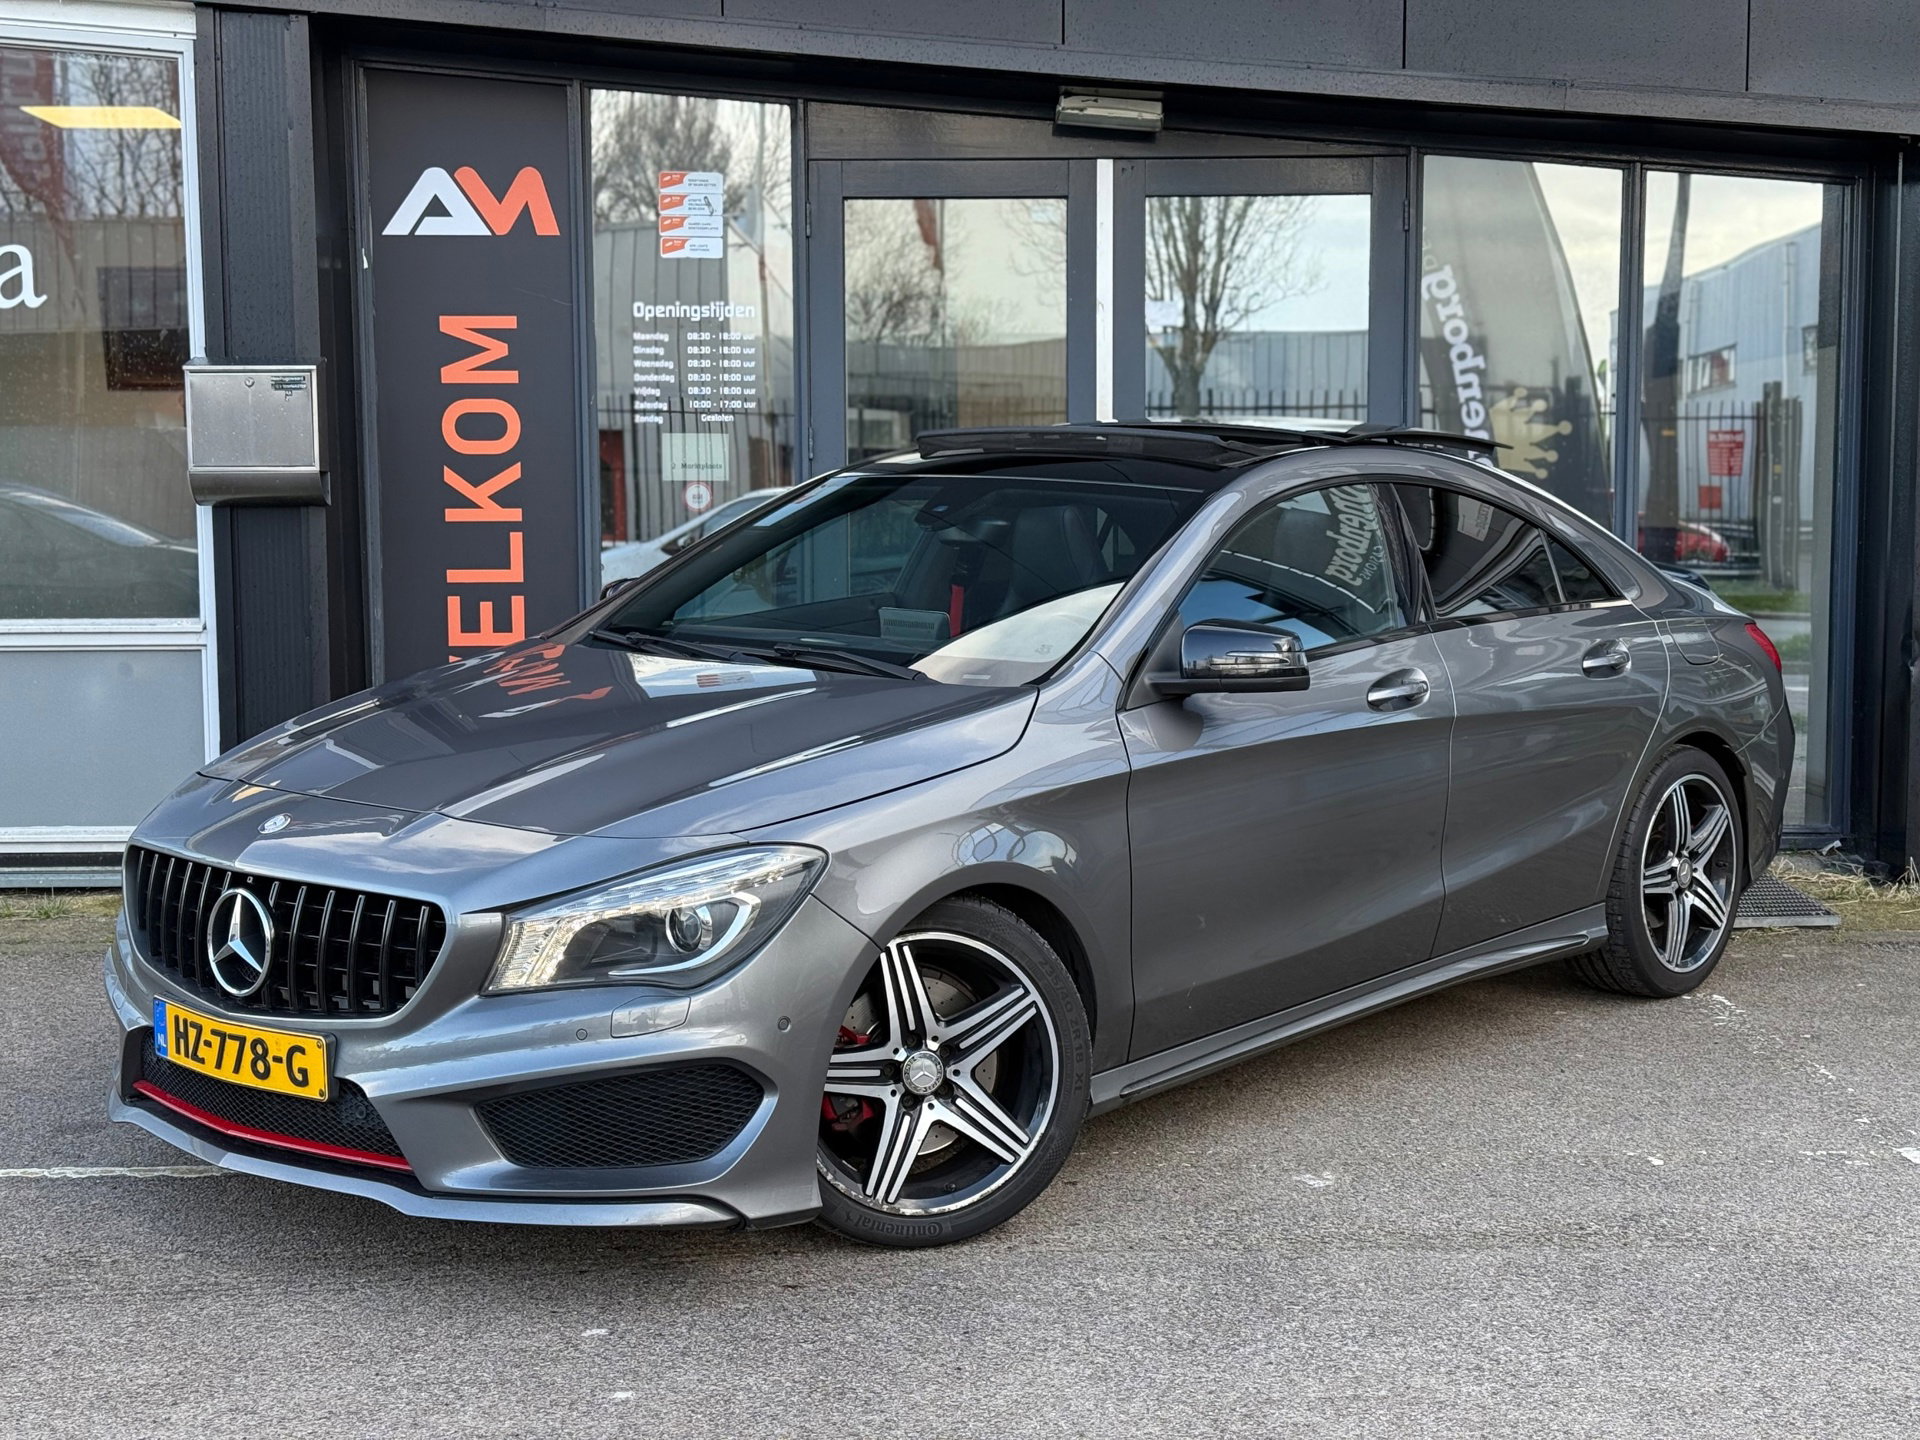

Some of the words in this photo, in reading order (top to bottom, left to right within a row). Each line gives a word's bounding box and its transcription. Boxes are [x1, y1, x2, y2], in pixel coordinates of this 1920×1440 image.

[633, 301, 755, 322] Openingstijden
[633, 332, 670, 342] Maandag
[687, 332, 711, 341] 08:30
[719, 332, 742, 341] 18:00
[633, 345, 664, 355] Dinsdag
[687, 346, 711, 354] 08:30
[719, 346, 742, 354] 18:00
[633, 359, 674, 369] Woensdag
[687, 359, 711, 368] 08:30
[719, 359, 742, 368] 18:00
[633, 373, 675, 383] Donderdag
[687, 373, 711, 382] 08:30
[719, 373, 742, 382] 18:00
[633, 387, 661, 396] Vrijdag
[687, 387, 711, 395] 08:30
[719, 387, 742, 395] 18:00
[634, 400, 668, 411] Zaterdag
[689, 400, 711, 409] 10:00
[719, 400, 742, 409] 17:00
[634, 415, 664, 424] Zondag
[701, 413, 734, 423] Gesloten
[441, 315, 525, 662] ELKOM
[157, 1033, 167, 1047] NL
[174, 1014, 310, 1088] HZ-778-G
[854, 1213, 944, 1238] Continental
